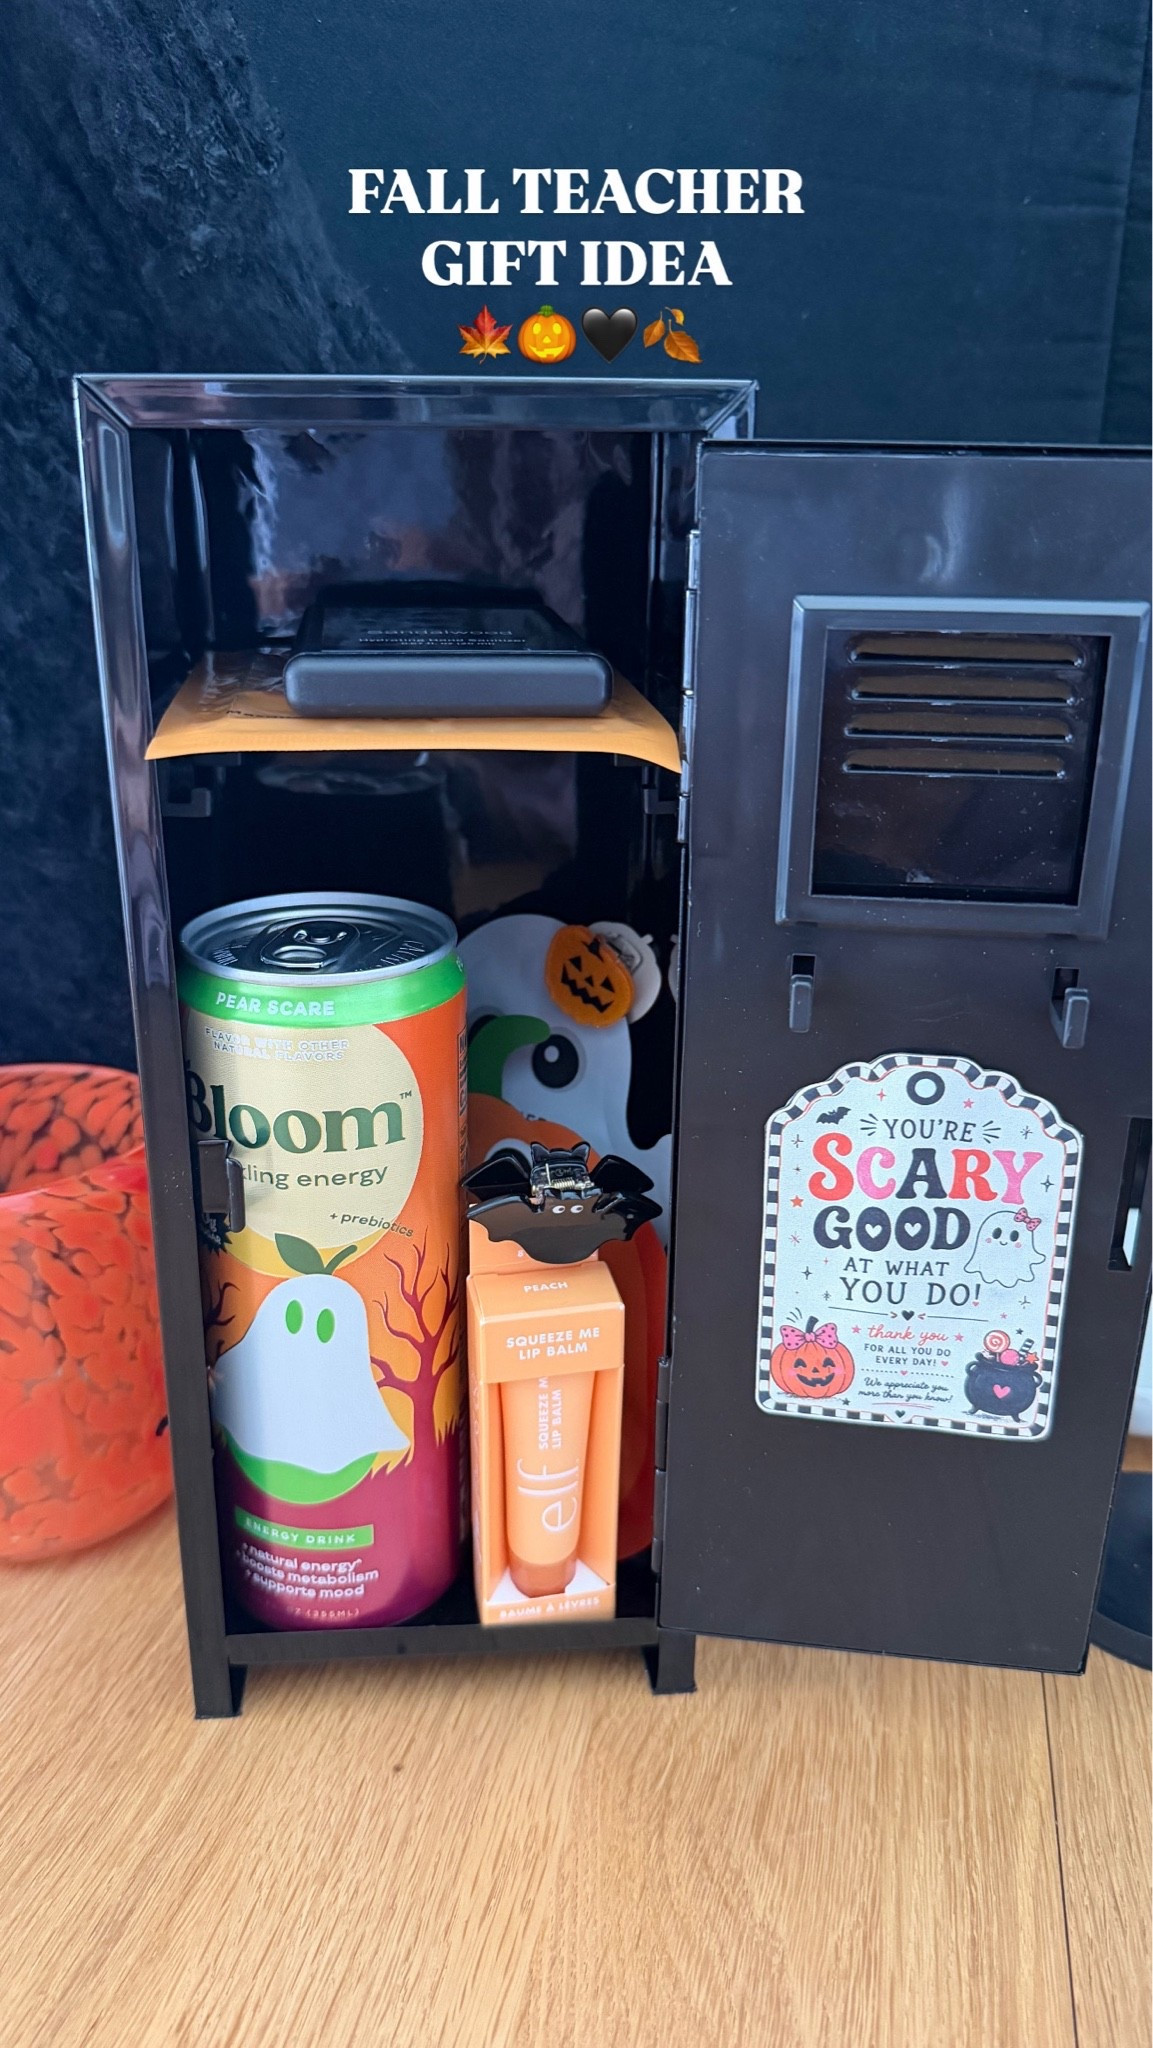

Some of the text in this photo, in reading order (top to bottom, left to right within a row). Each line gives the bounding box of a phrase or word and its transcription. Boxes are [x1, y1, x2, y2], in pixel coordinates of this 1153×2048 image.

[216, 992, 335, 1016] PEAR SCARE
[276, 1050, 344, 1061] FLAVORS
[300, 1039, 349, 1051] OTHER
[187, 1069, 406, 1154] Bloom
[882, 1118, 977, 1143] YOU'RE
[296, 1165, 389, 1188] energy
[808, 1132, 1044, 1205] SCARY
[340, 1210, 414, 1238] prebiotics
[813, 1205, 971, 1251] GOOD
[843, 1257, 950, 1277] AT WHAT
[523, 1281, 568, 1293] PEACH
[839, 1276, 981, 1307] YOU DO!
[506, 1327, 600, 1349] SQUEEZE ME
[867, 1323, 949, 1346] thank you
[519, 1342, 588, 1360] LIP BALM
[864, 1343, 951, 1357] FOR ALL YOU DO
[875, 1355, 937, 1367] EVERY DAY!
[863, 1376, 949, 1393] We appreciate you
[882, 1389, 904, 1399] than
[905, 1393, 923, 1402] you
[924, 1392, 953, 1403] know!
[538, 1393, 549, 1450] SQUEEZE
[551, 1388, 562, 1449] LIP BALM
[245, 1517, 356, 1544] ENERGY DRINK
[252, 1573, 316, 1597] supports
[320, 1583, 365, 1598] mood
[287, 1569, 379, 1585] metabolism
